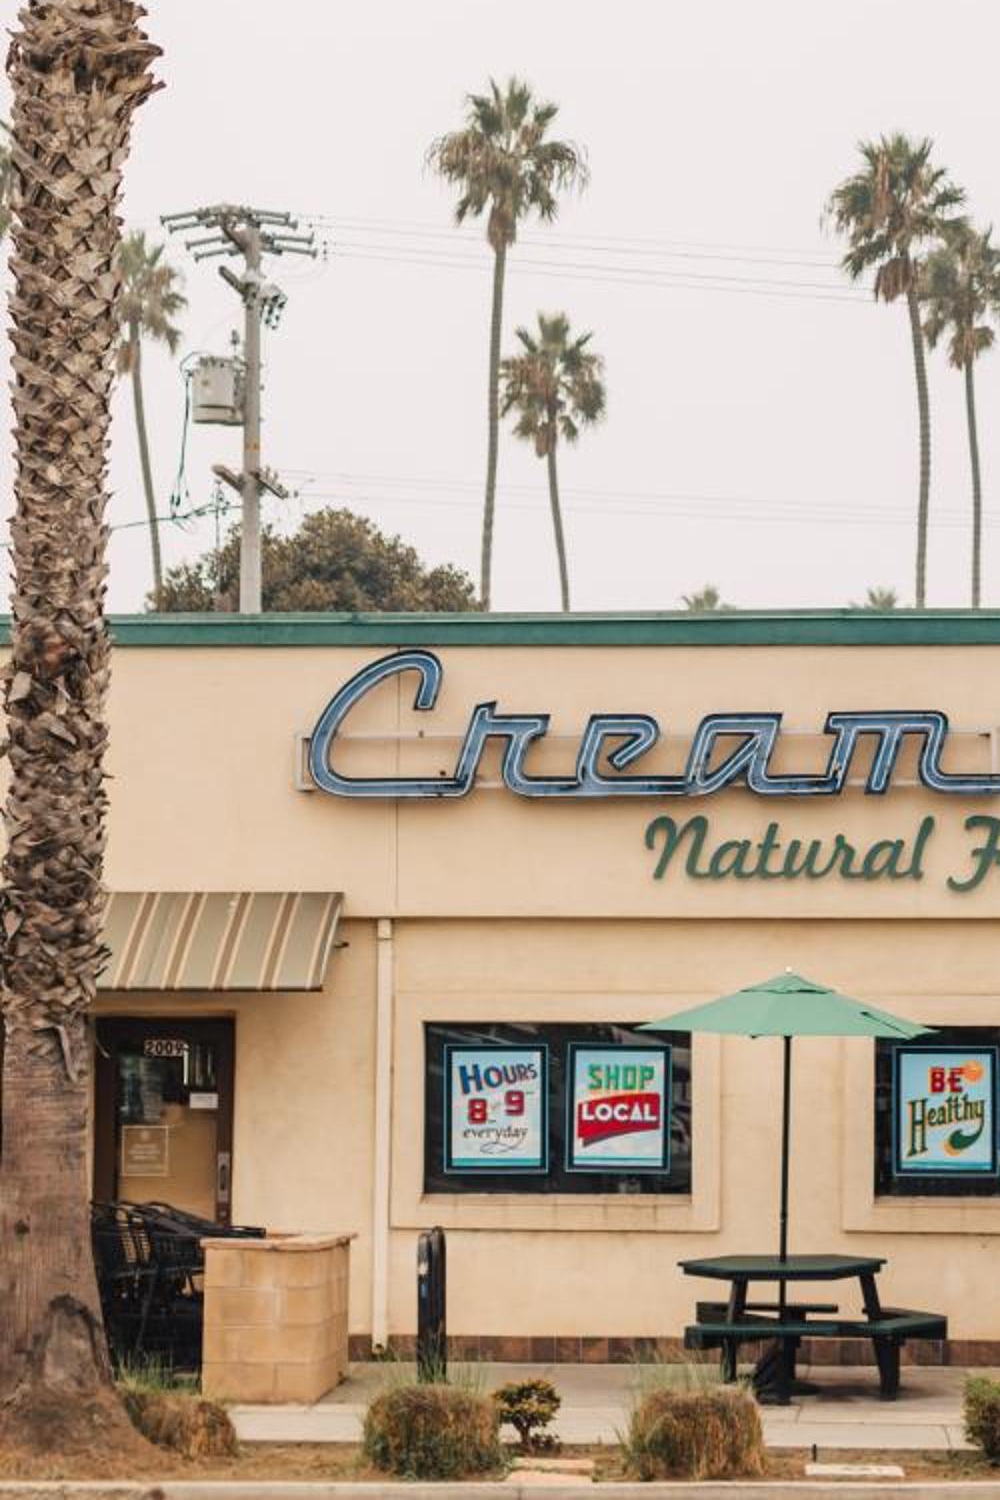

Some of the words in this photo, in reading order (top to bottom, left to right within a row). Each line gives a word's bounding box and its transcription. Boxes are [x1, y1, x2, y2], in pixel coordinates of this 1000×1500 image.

[644, 814, 936, 881] Natural
[459, 1063, 538, 1094] HOURS
[588, 1063, 655, 1090] SHOP
[929, 1066, 965, 1093] BE
[466, 1098, 488, 1125] 8
[504, 1090, 525, 1117] 9
[582, 1103, 658, 1122] LOCAL
[463, 1126, 529, 1145] everyday
[907, 1093, 985, 1157] Healthy
